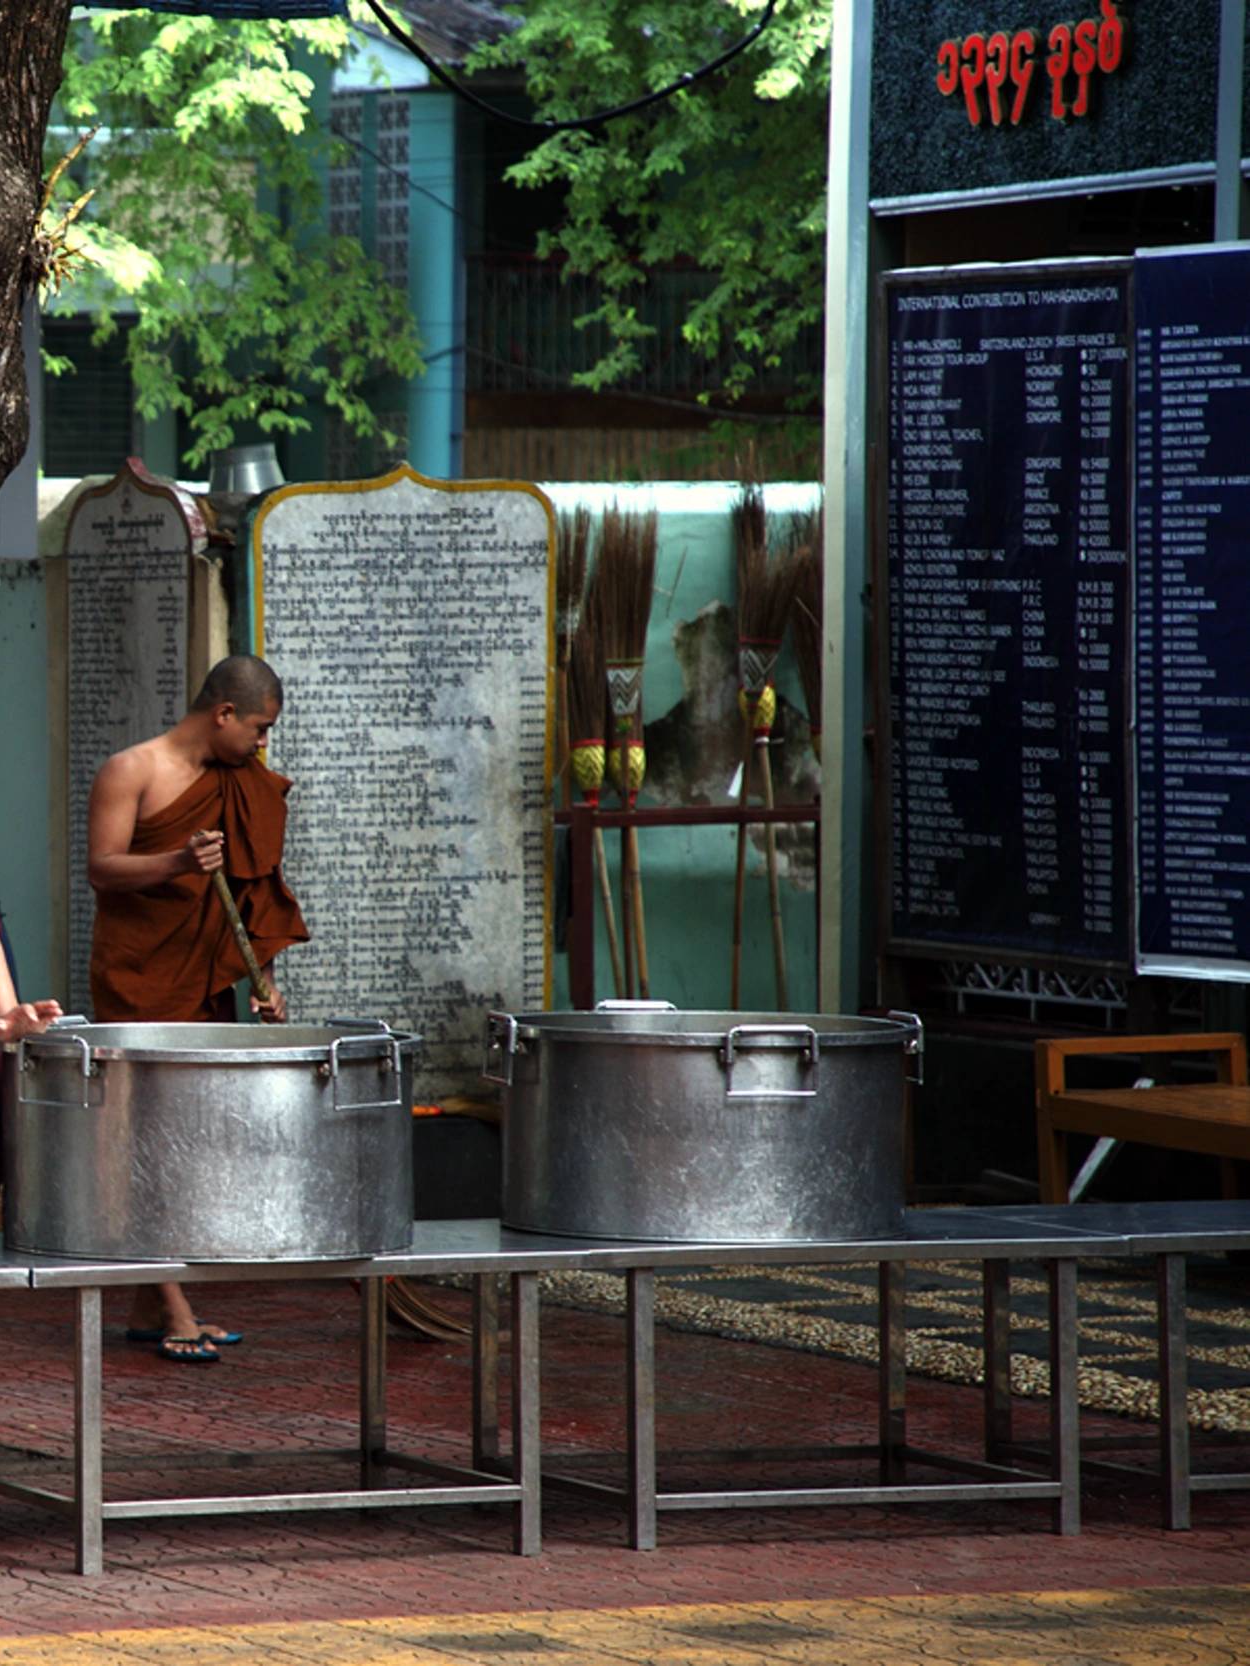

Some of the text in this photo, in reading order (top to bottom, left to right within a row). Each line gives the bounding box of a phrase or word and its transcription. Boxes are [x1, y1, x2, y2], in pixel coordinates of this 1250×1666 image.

[898, 295, 961, 311] INTERNATIONAL
[962, 292, 1026, 309] CONTRIBUTION
[1028, 291, 1040, 305] TO
